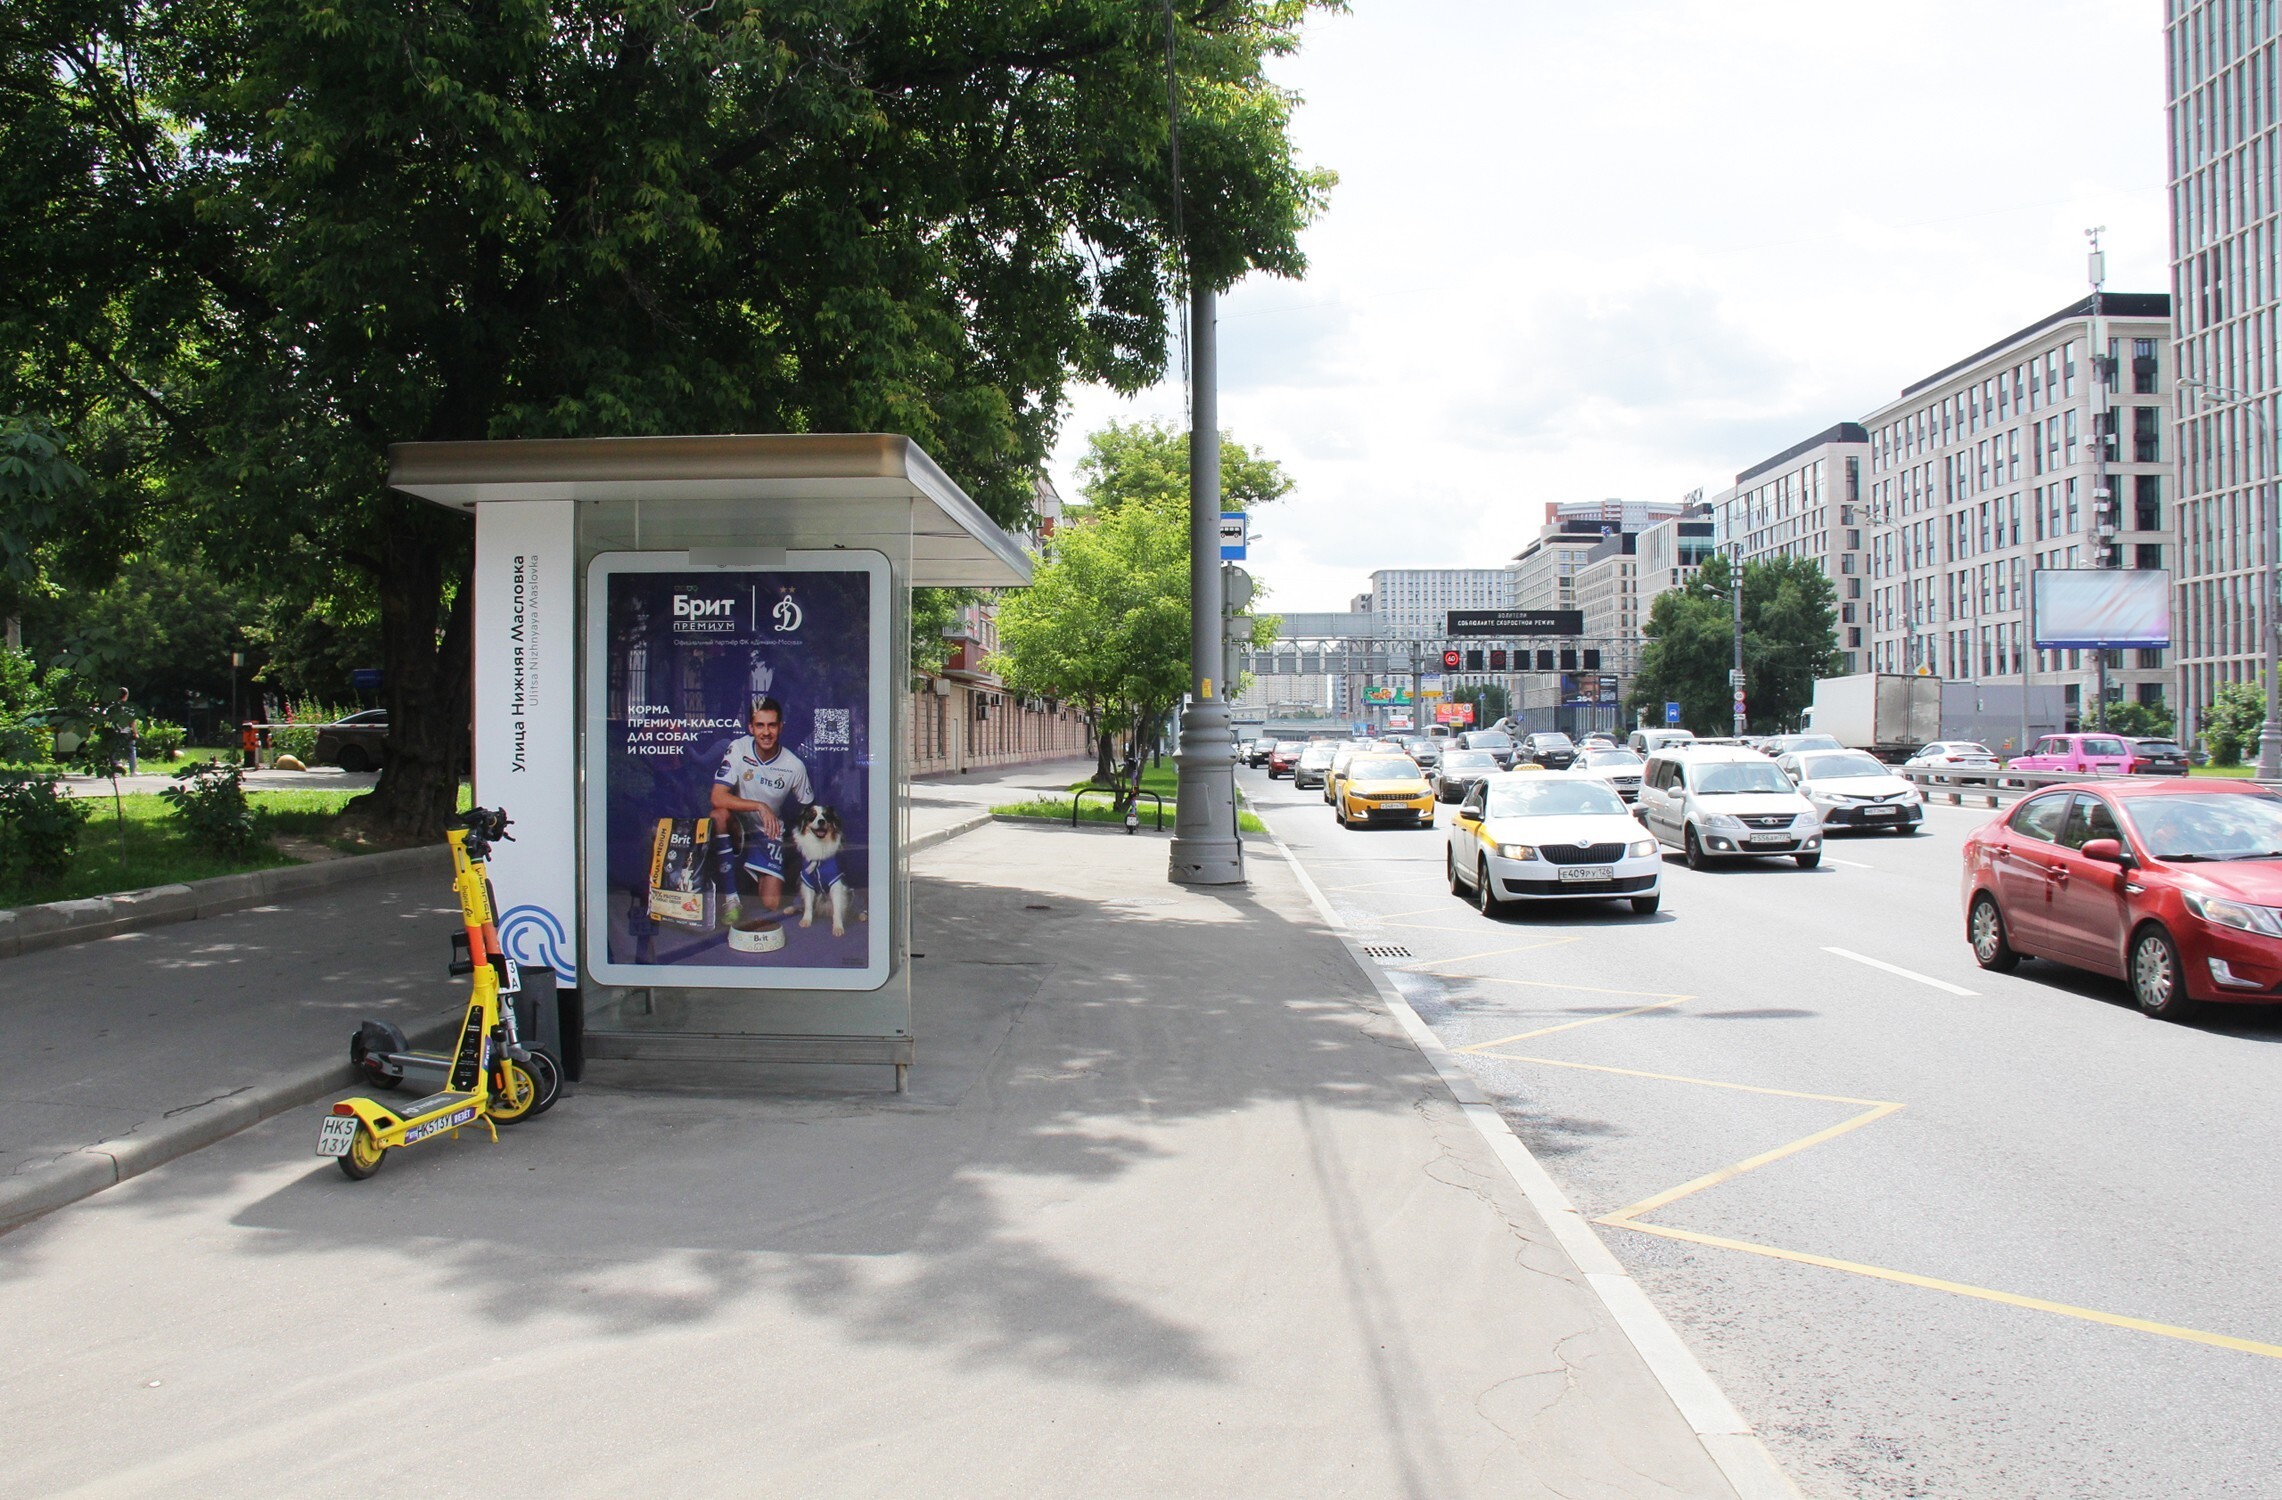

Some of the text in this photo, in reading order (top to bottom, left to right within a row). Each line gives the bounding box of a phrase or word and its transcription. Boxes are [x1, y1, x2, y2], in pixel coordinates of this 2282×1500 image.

[673, 594, 735, 620] Брит
[528, 554, 540, 706] Ulitsa Nizhnyaya Maslovka
[673, 622, 735, 631] ПРЕМИУМ
[510, 555, 527, 773] Улица Нижняя Масловка
[628, 705, 670, 715] КОРМА
[627, 718, 742, 729] ПРЕМИУМ-КЛАССА
[627, 732, 698, 743] ДЛЯ СОБАК
[627, 745, 684, 755] И КОШЕК
[760, 777, 773, 787] ВТБ
[670, 833, 692, 845] Brit
[767, 842, 783, 865] 74
